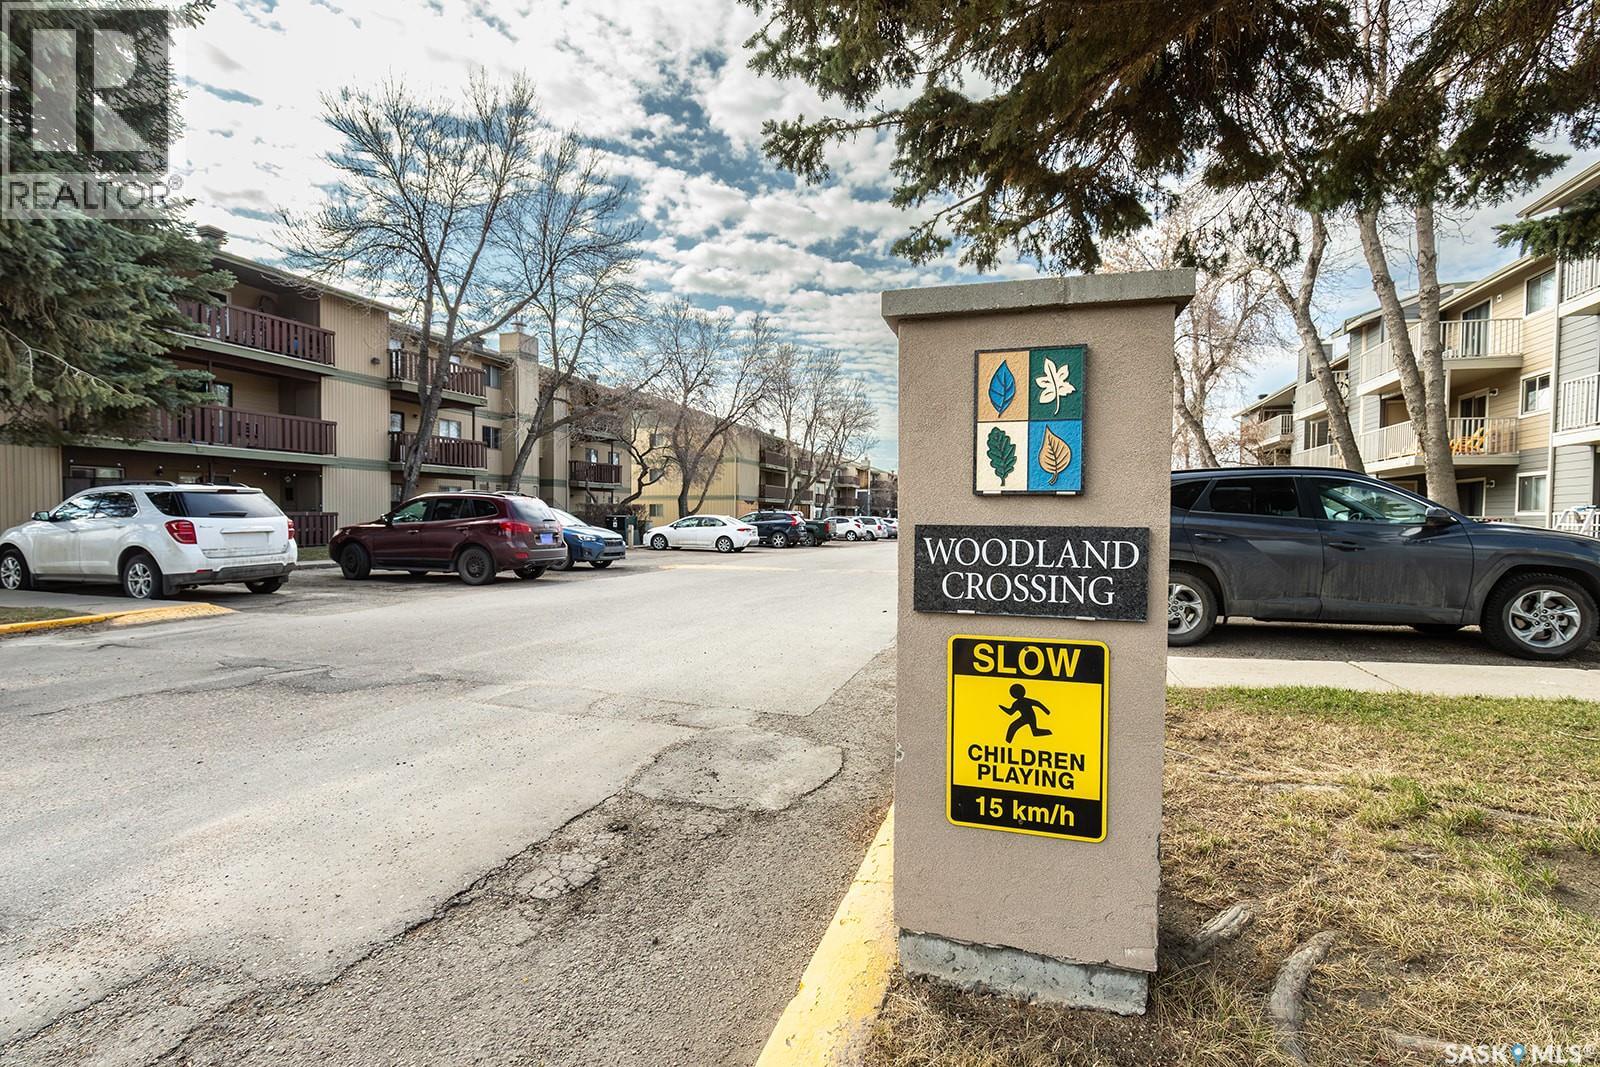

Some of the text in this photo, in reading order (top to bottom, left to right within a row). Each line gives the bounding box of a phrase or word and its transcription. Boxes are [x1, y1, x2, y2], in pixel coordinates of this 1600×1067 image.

[923, 538, 1139, 569] WOODLAND
[941, 571, 1116, 606] CROSSING
[972, 643, 1081, 677] SLOW
[967, 744, 1086, 772] CHILDREN
[977, 764, 1075, 790] PLAYING
[975, 795, 1075, 827] 15 km/h
